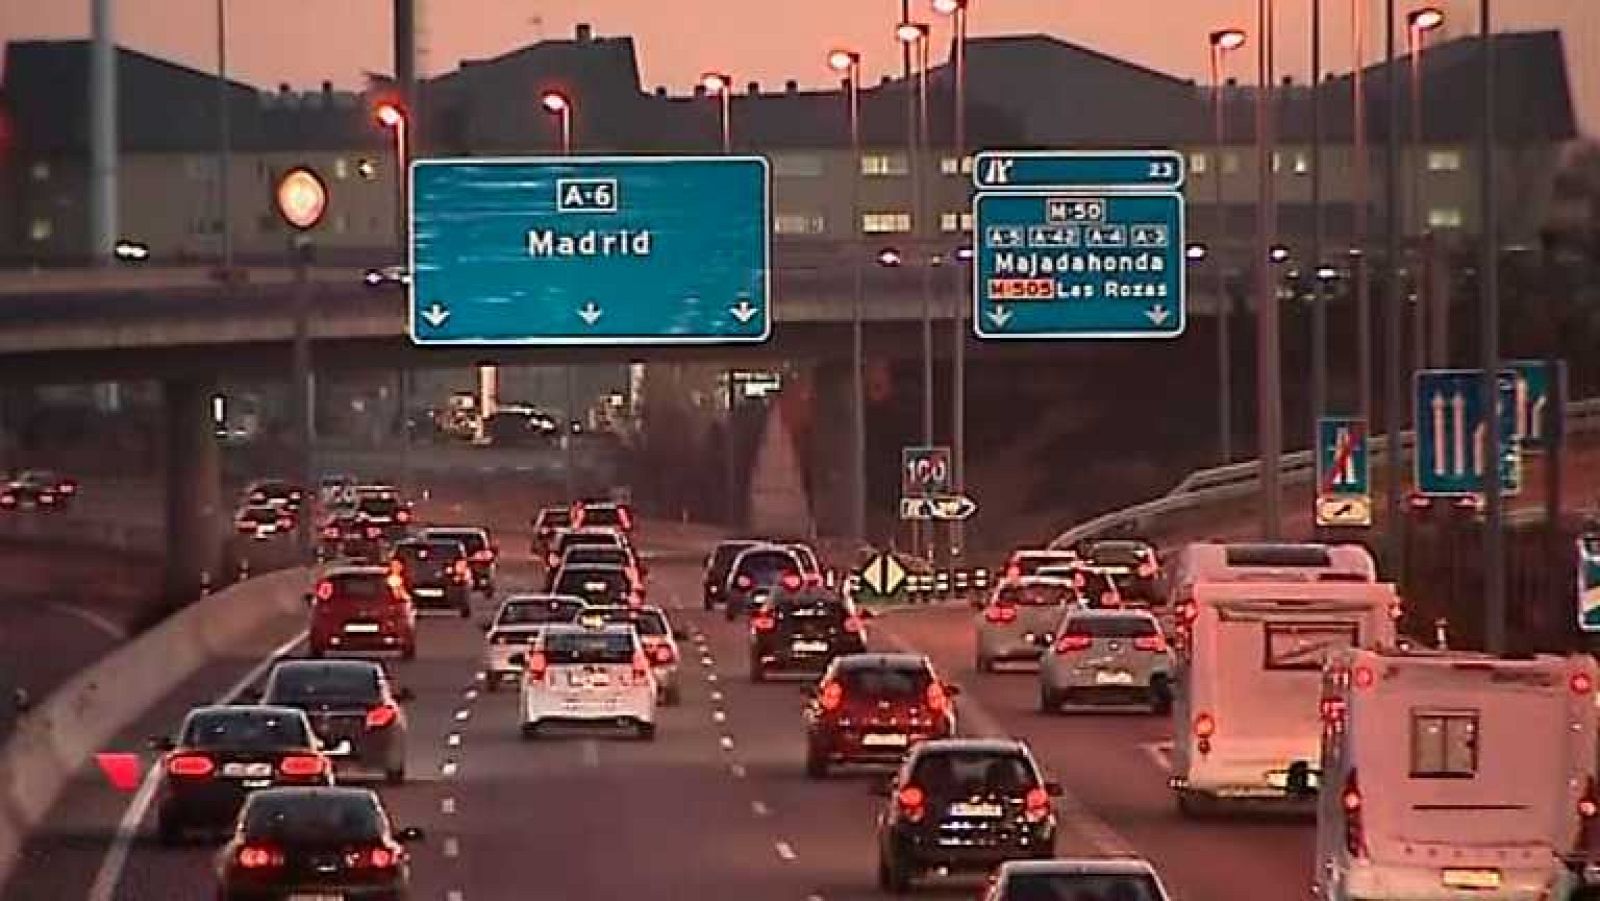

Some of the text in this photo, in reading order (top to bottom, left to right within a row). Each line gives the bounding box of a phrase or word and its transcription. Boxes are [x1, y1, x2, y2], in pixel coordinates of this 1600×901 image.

[527, 229, 651, 257] Madrid
[995, 252, 1164, 276] Majadahonda
[1057, 282, 1094, 297] Las
[1105, 281, 1167, 297] Rozas
